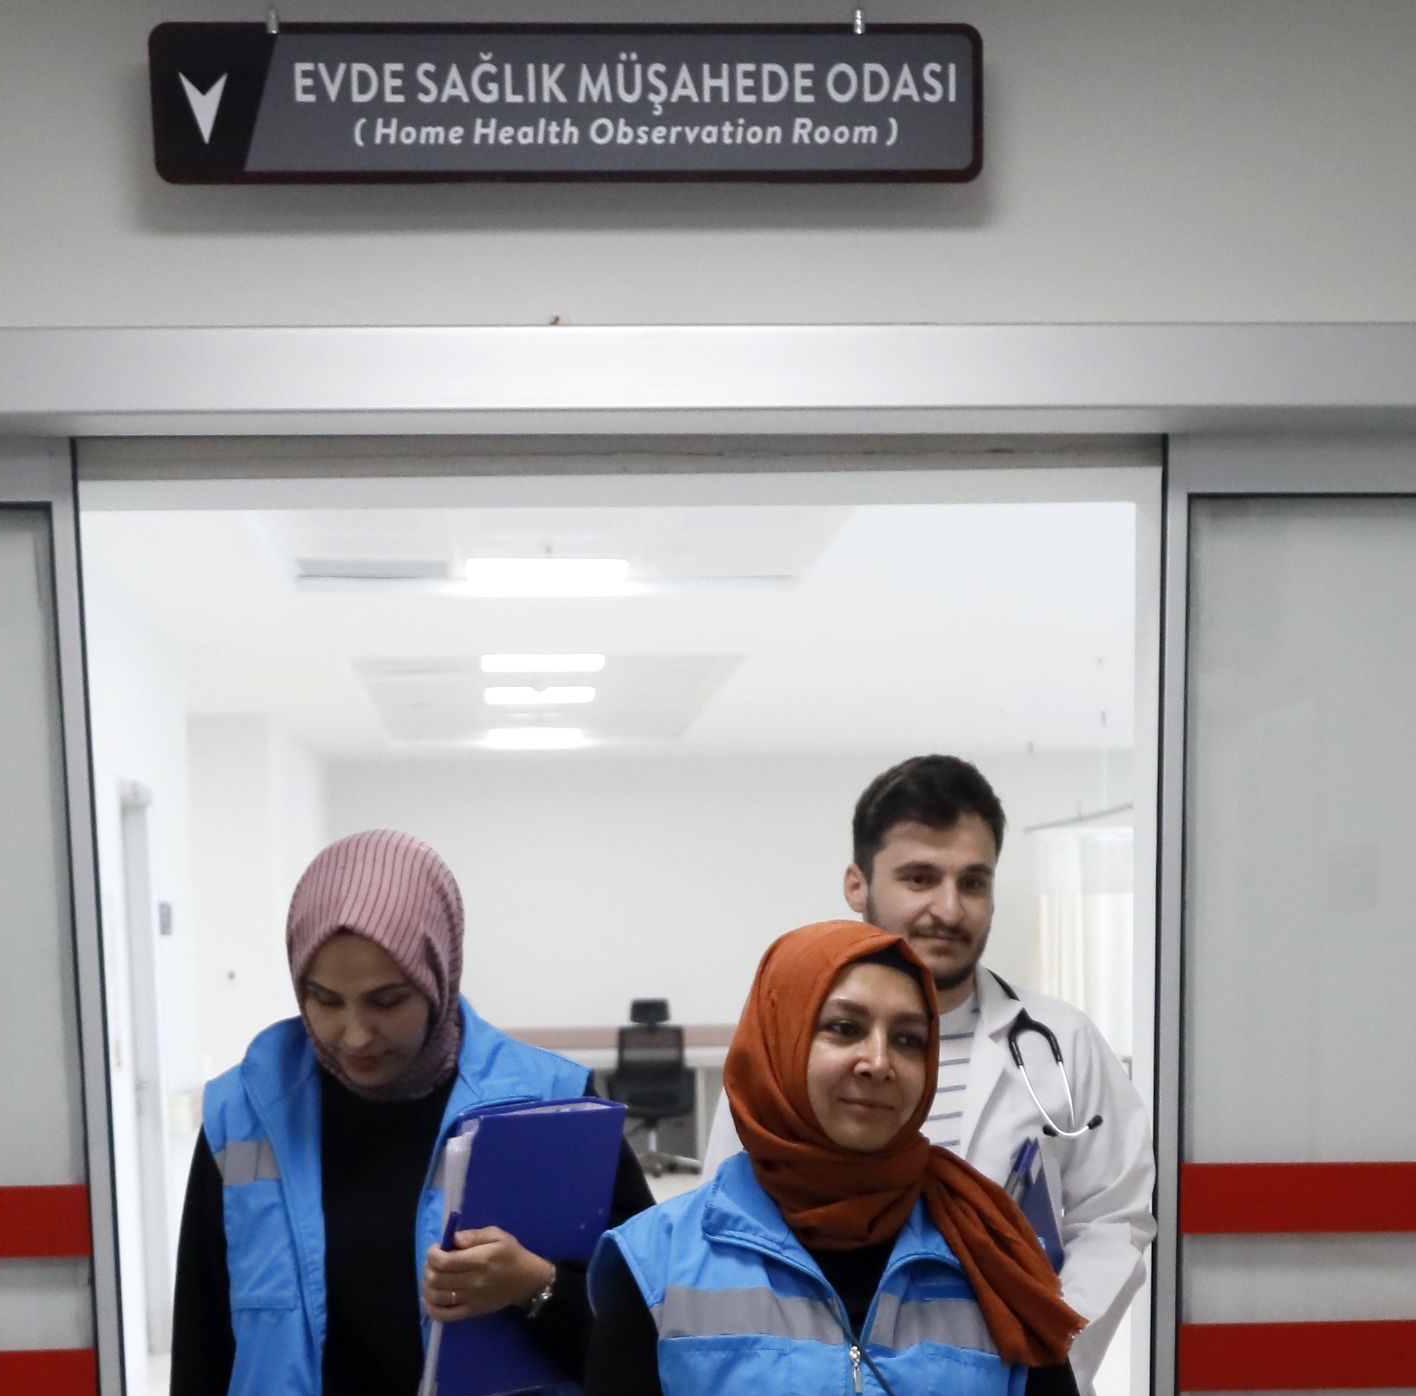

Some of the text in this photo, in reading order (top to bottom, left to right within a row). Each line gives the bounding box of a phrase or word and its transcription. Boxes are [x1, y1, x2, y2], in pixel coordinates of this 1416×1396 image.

[294, 52, 956, 116] EVDE SAĞLIK MÜŞAHEDE ODASI
[473, 117, 580, 145] Health
[589, 117, 783, 145] Observation
